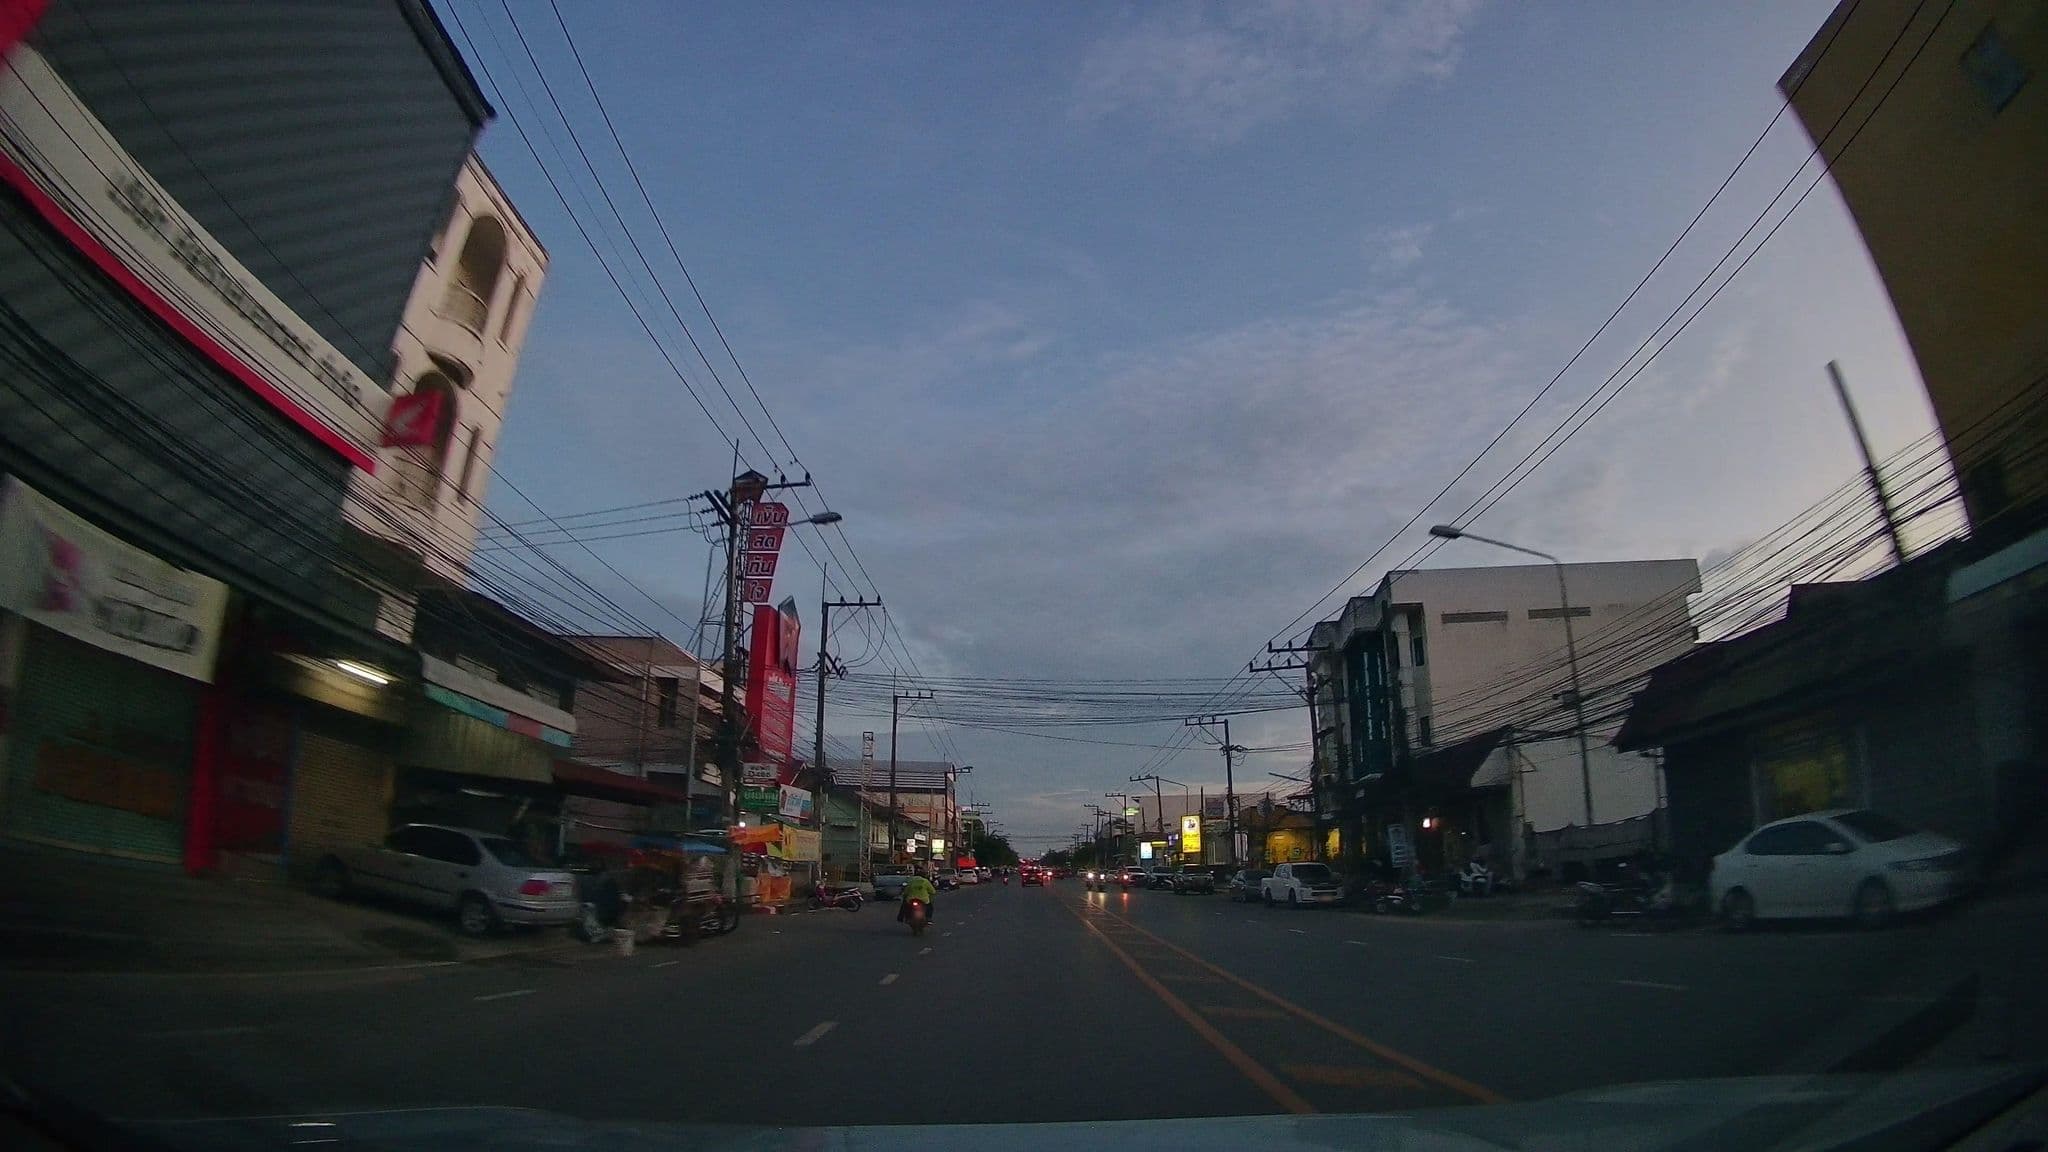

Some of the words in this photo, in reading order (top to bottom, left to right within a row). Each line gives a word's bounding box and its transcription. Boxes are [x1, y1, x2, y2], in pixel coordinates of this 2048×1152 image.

[755, 506, 785, 524] เงิน
[753, 535, 776, 548] สด
[749, 580, 766, 600] ใจ
